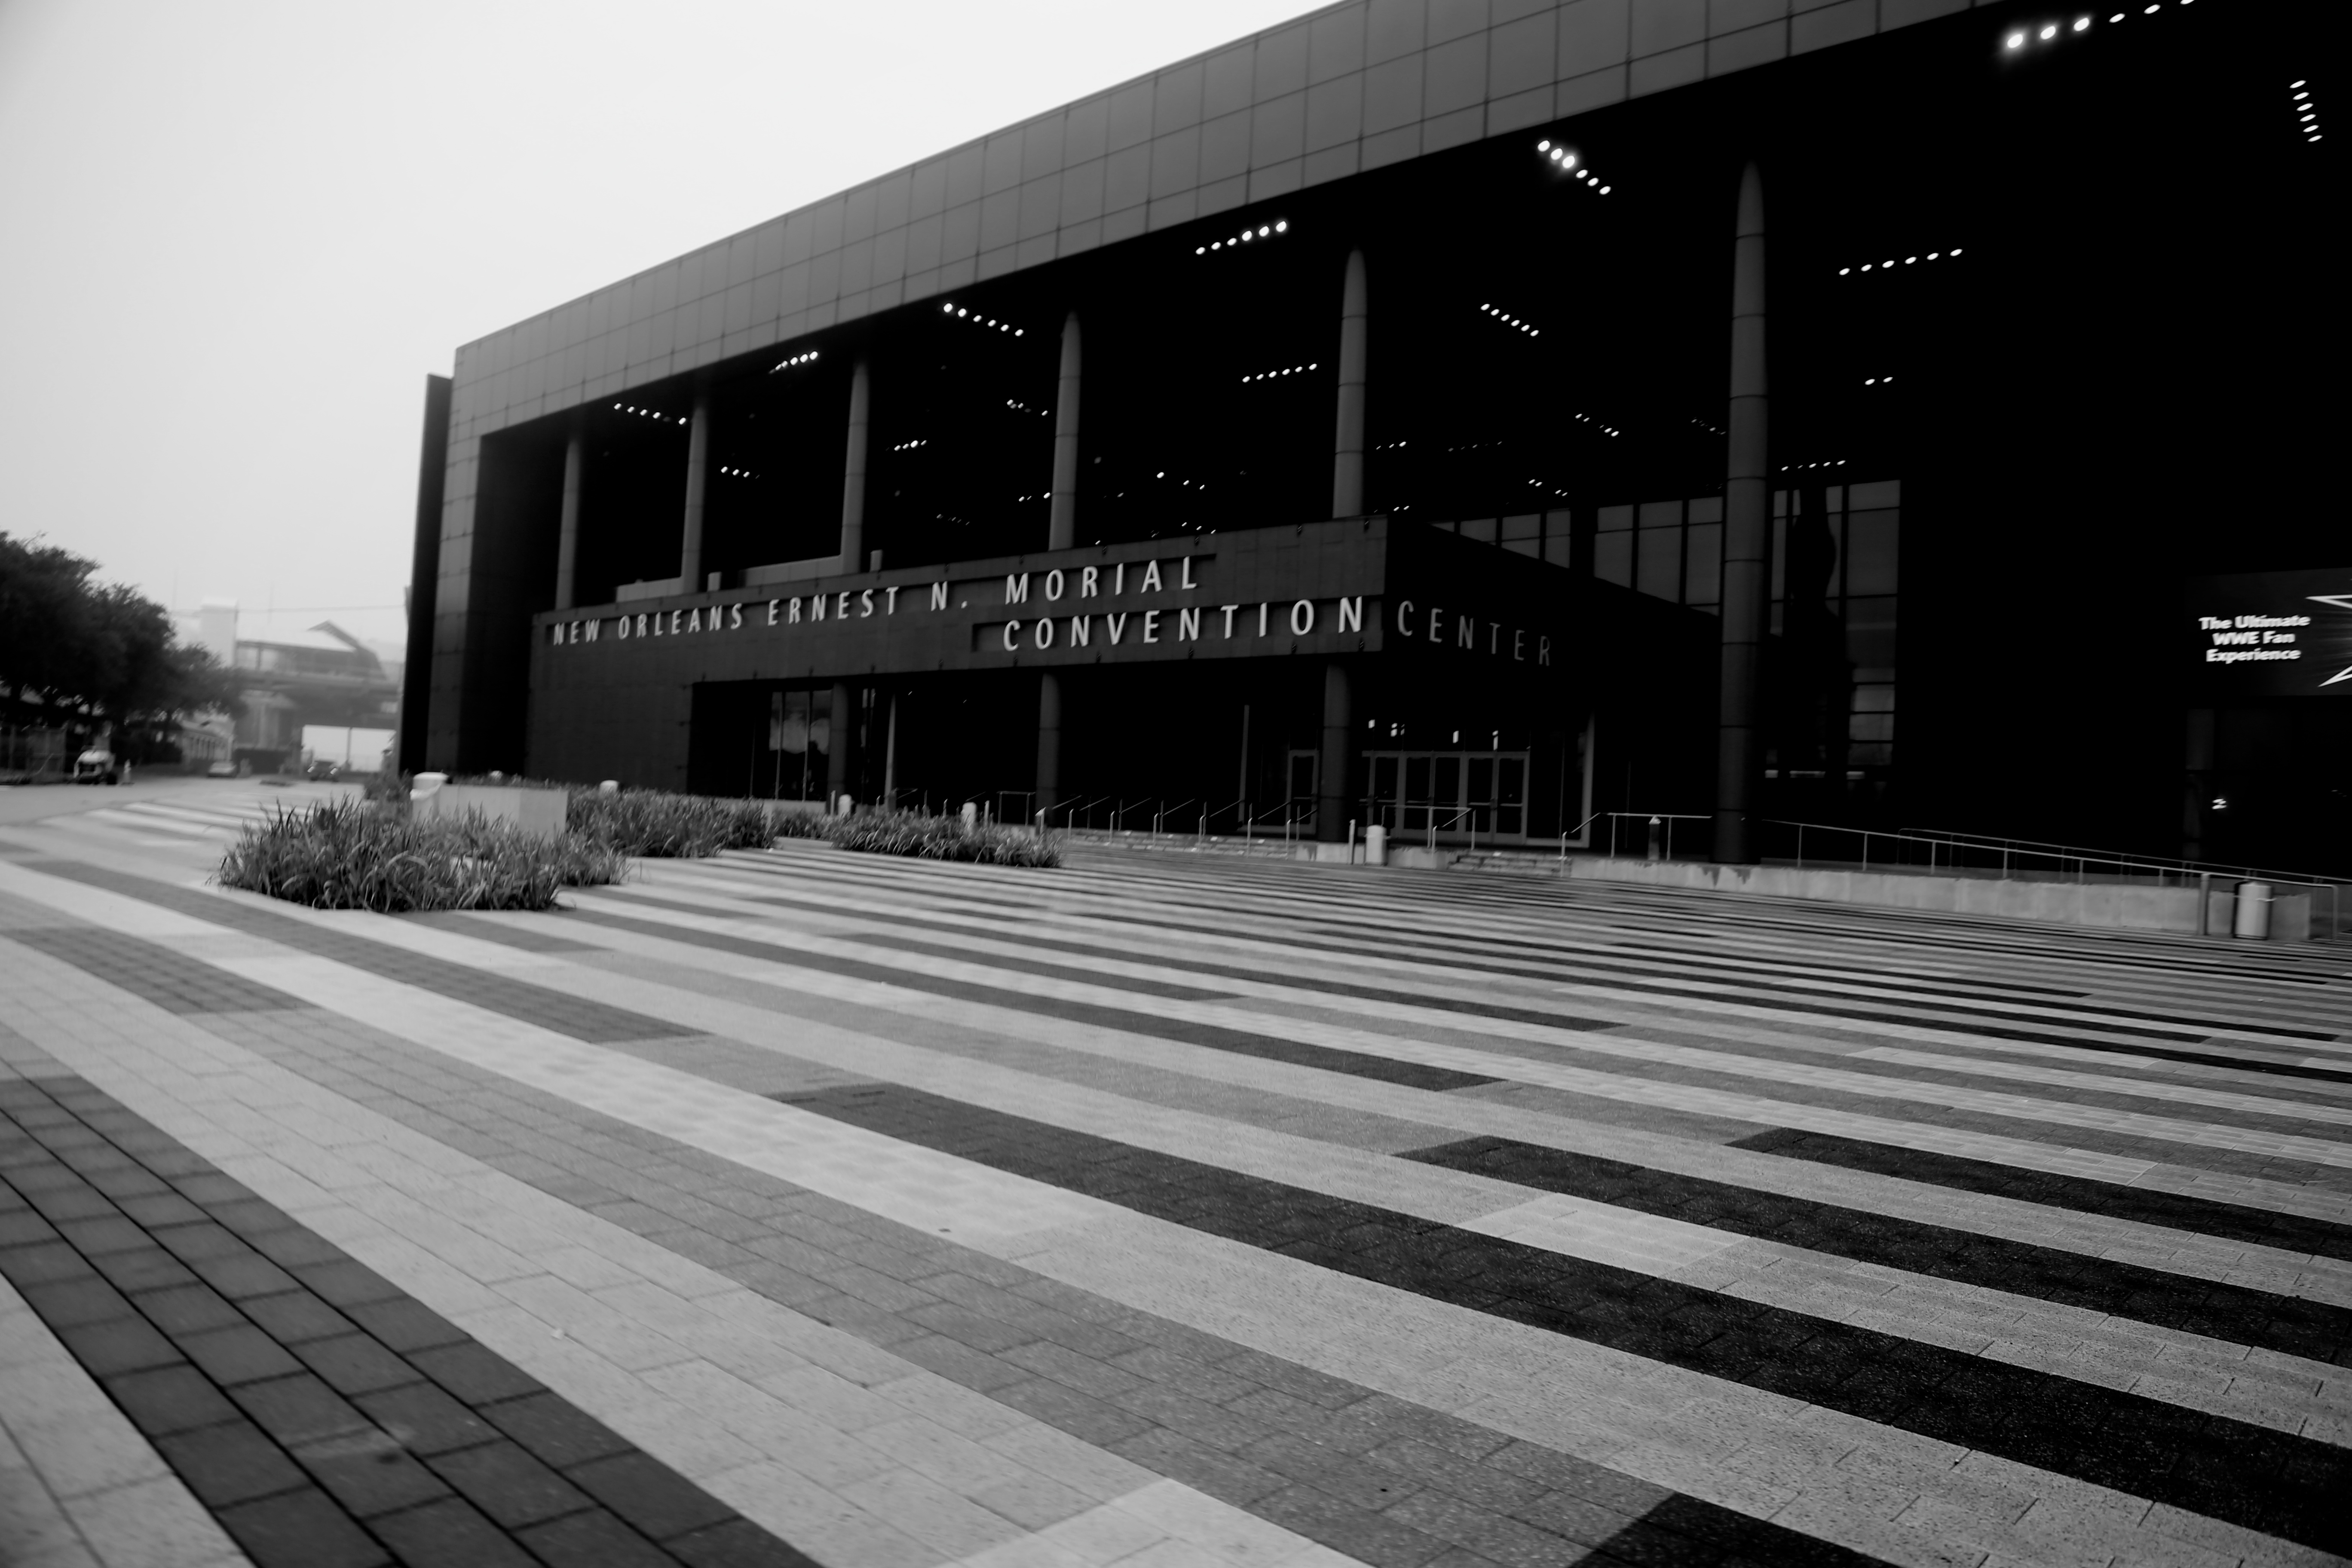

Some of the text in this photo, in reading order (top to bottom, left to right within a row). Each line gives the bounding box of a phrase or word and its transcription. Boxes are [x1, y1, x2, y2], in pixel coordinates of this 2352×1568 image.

[554, 557, 1197, 646] NEW ORLEANS ERNEST N. MORIAL
[2198, 614, 2311, 630] The Ultimate
[1003, 596, 1551, 667] CONVENTION CENTER
[2212, 631, 2296, 646] WWE Fan
[2205, 647, 2302, 665] Experience
